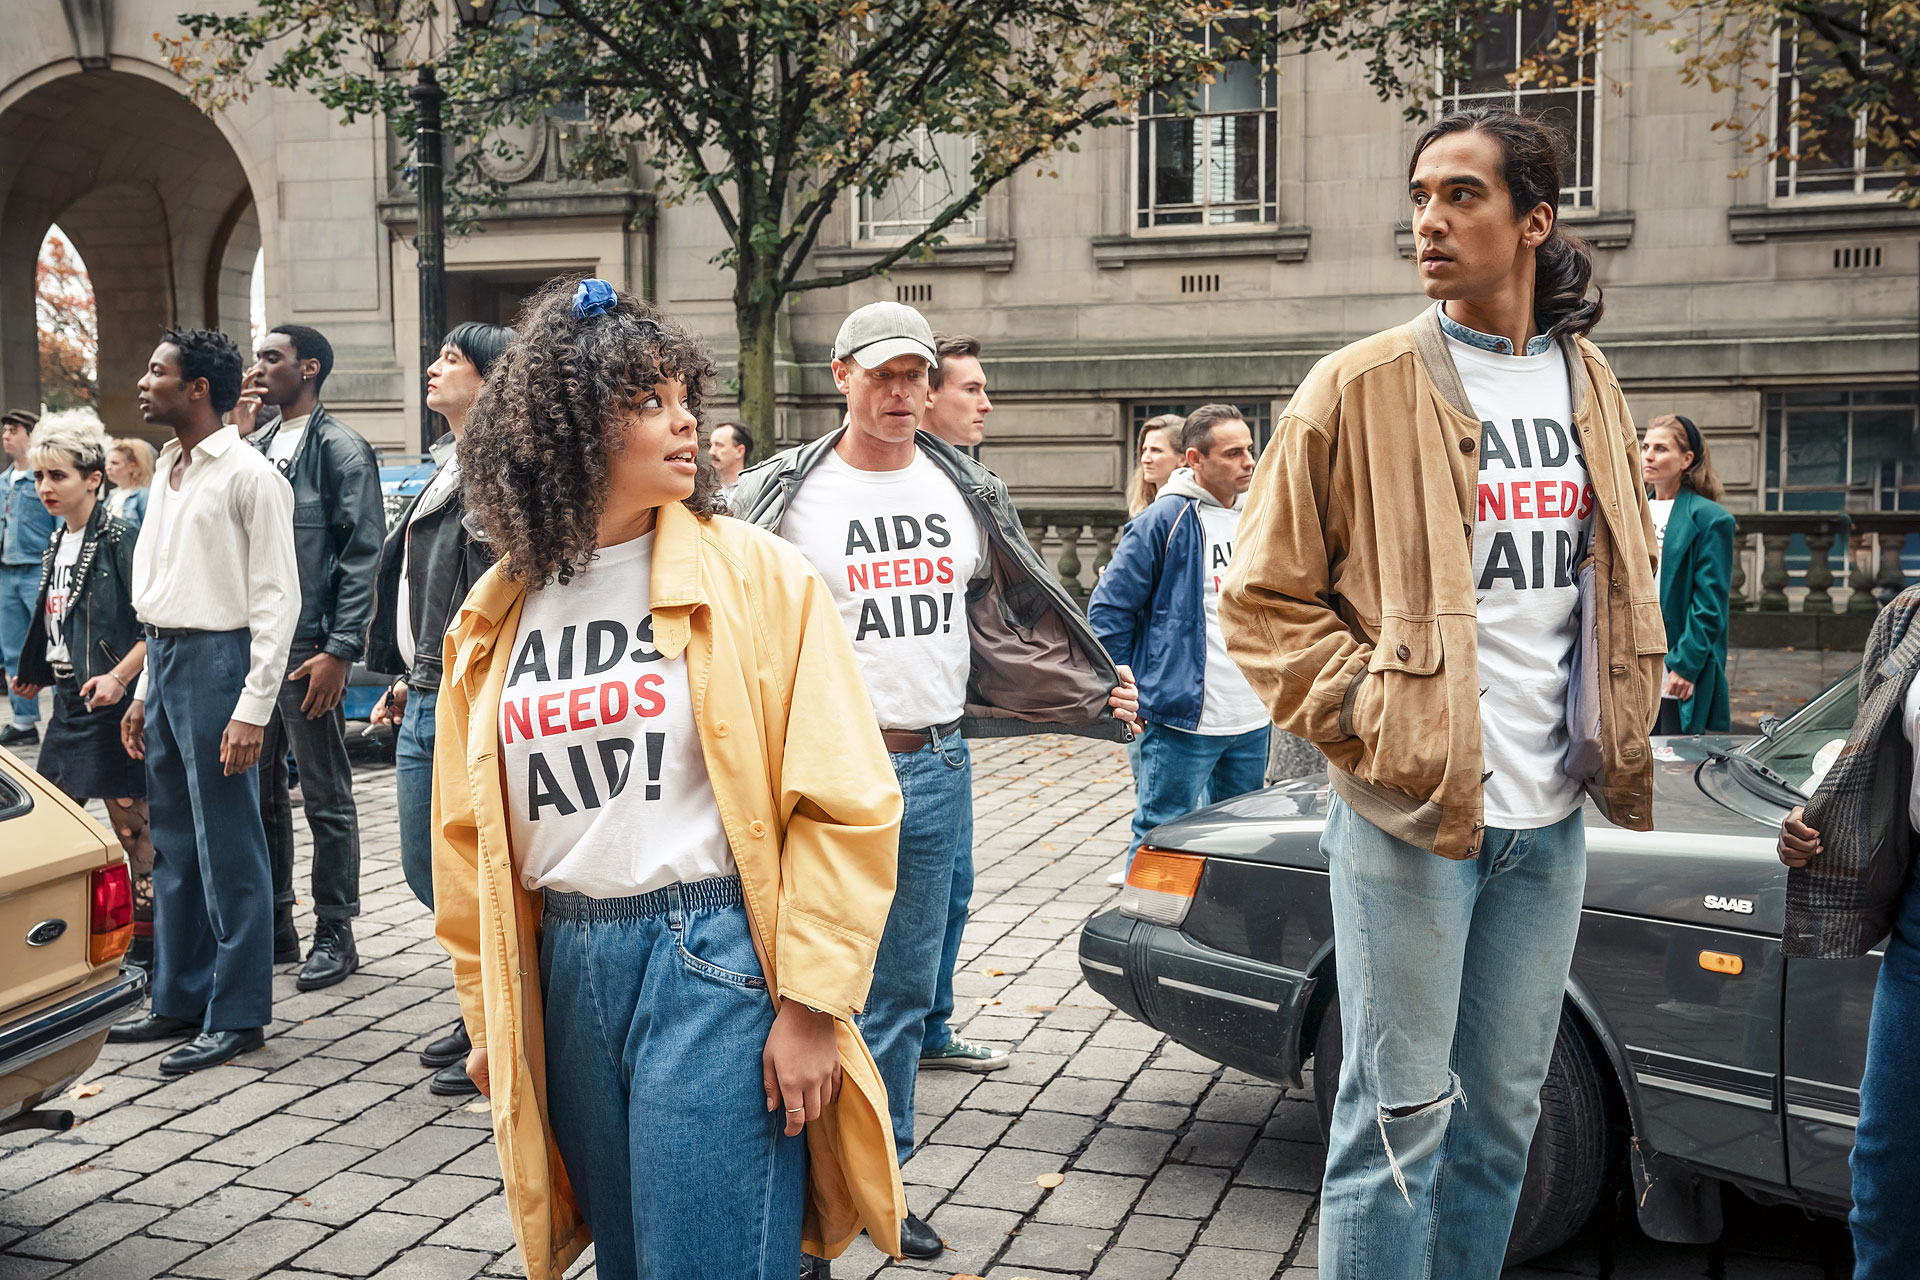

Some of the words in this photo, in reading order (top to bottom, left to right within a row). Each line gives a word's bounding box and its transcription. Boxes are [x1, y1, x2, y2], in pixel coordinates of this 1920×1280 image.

[1478, 481, 1594, 522] NEEDS
[845, 513, 952, 556] AIDS
[847, 556, 954, 592] NEEDS
[856, 592, 954, 641] AID!
[504, 673, 666, 744] NEEDS
[528, 732, 665, 821] AID!
[1703, 895, 1753, 914] SAAB
